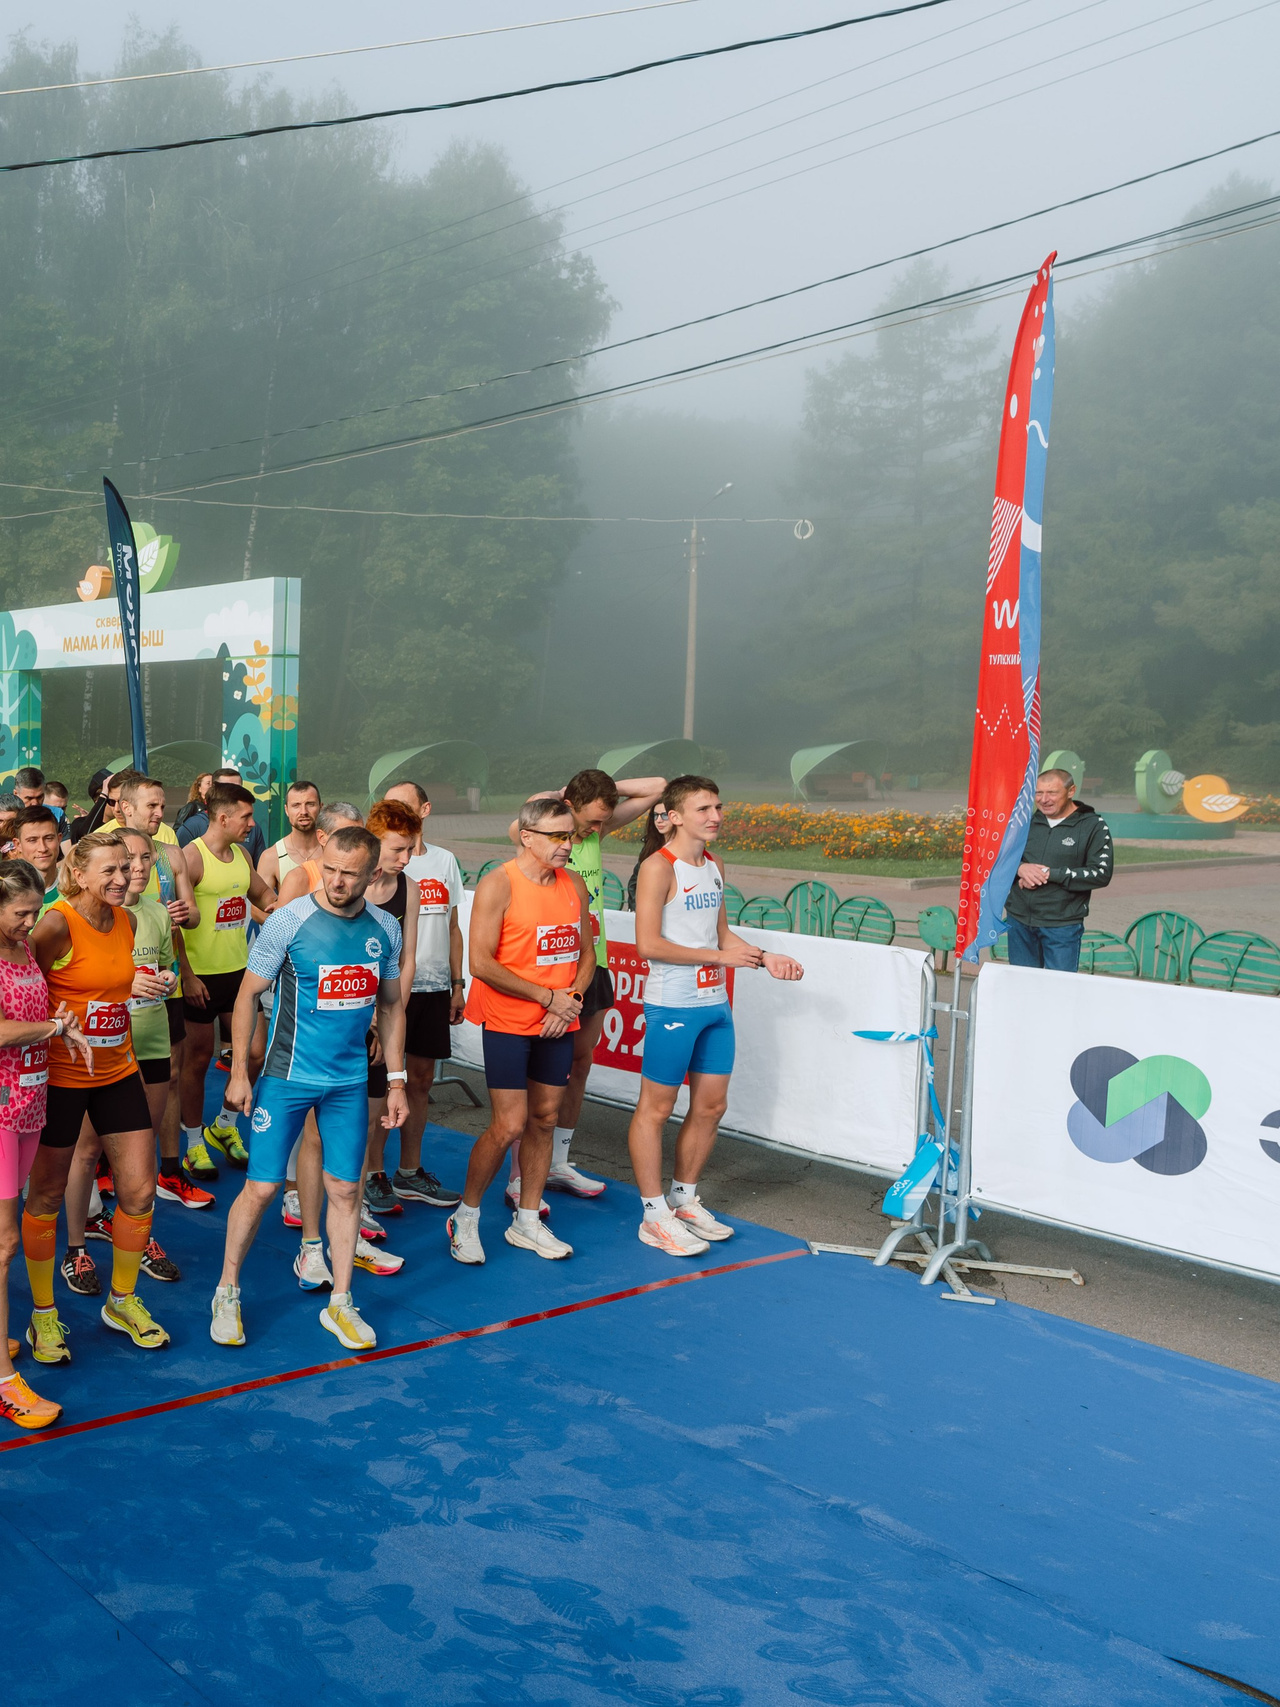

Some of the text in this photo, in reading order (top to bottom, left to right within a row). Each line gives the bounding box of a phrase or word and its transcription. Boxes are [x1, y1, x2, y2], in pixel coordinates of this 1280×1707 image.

[96, 615, 122, 630] сквер
[63, 629, 164, 653] МАМА И МЫШ
[988, 651, 1022, 666] ТУЛСКИЙ
[420, 888, 443, 900] 2014
[226, 905, 243, 917] 2051
[549, 935, 575, 949] 2028
[333, 978, 368, 992] 2003
[99, 1015, 126, 1029] 2263
[596, 1008, 647, 1057] 9.2
